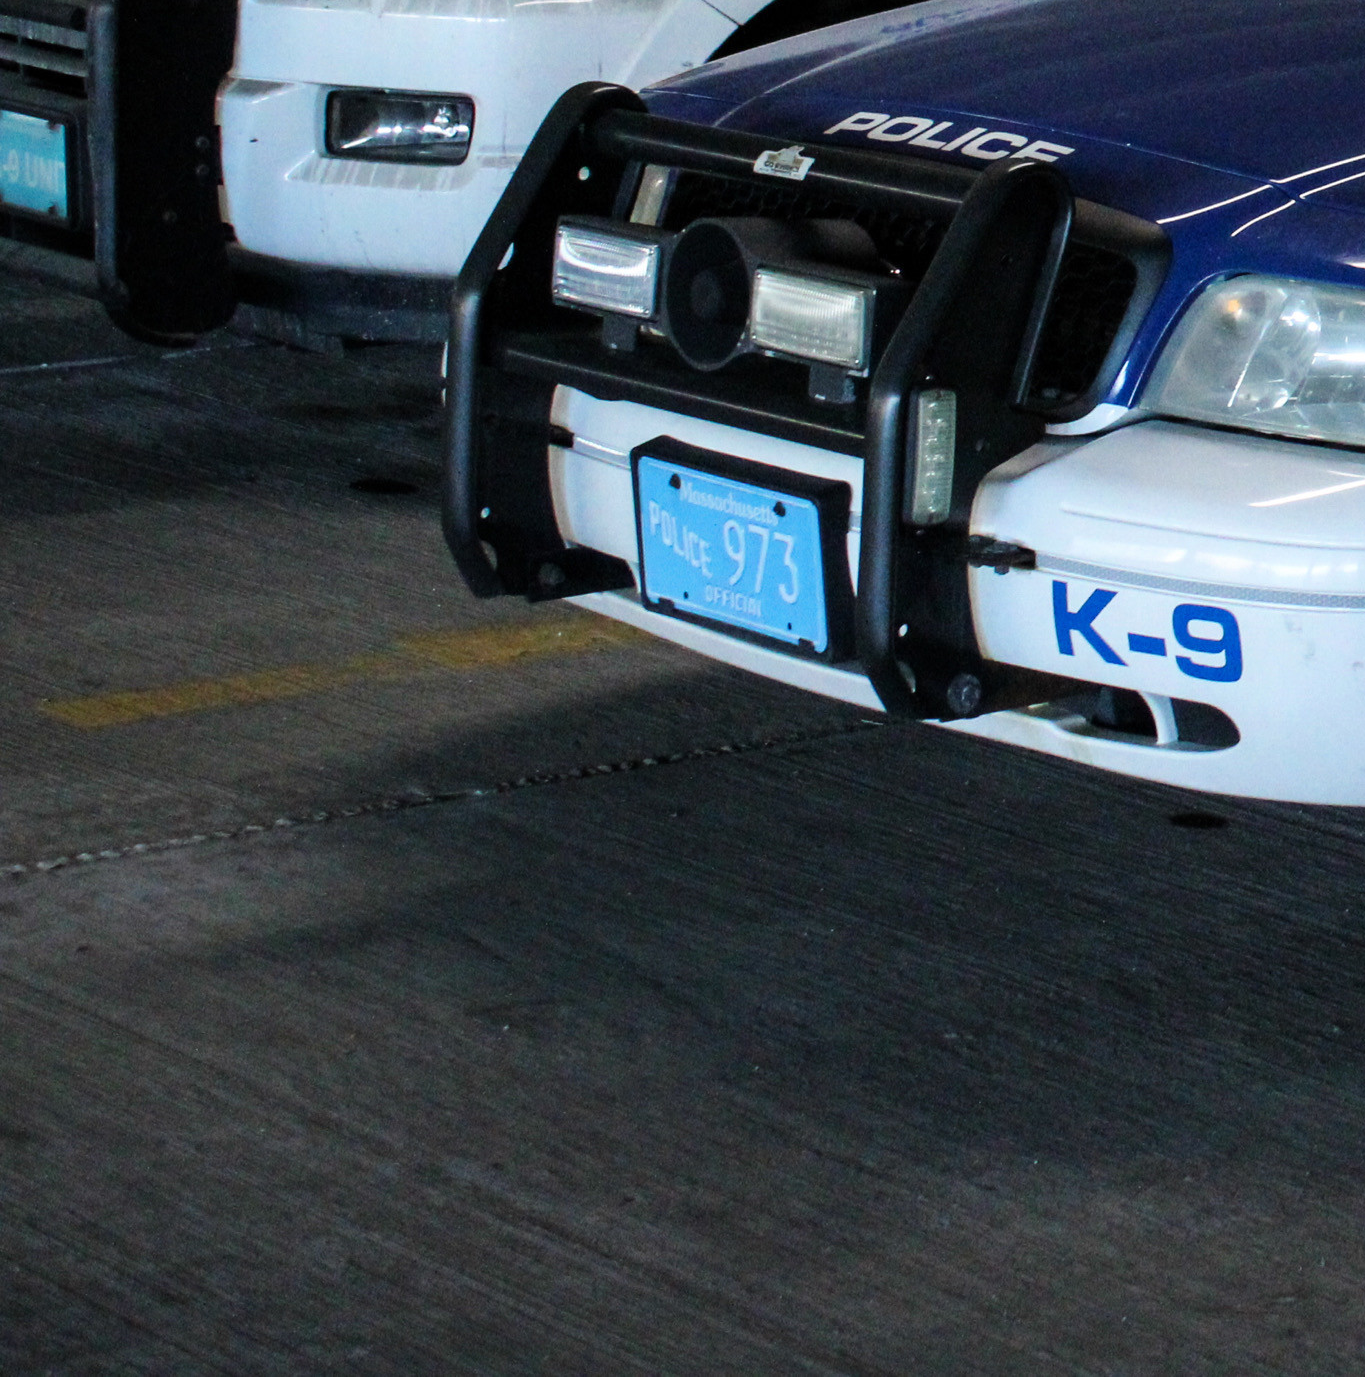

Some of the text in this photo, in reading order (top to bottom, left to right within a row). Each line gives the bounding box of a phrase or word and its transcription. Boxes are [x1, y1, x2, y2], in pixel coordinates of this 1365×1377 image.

[823, 111, 1076, 164] POLICE
[679, 479, 779, 527] Massachusetts
[648, 500, 800, 605] POLICE 973
[704, 584, 762, 618] OFFICIAL
[1052, 579, 1243, 682] K-9
